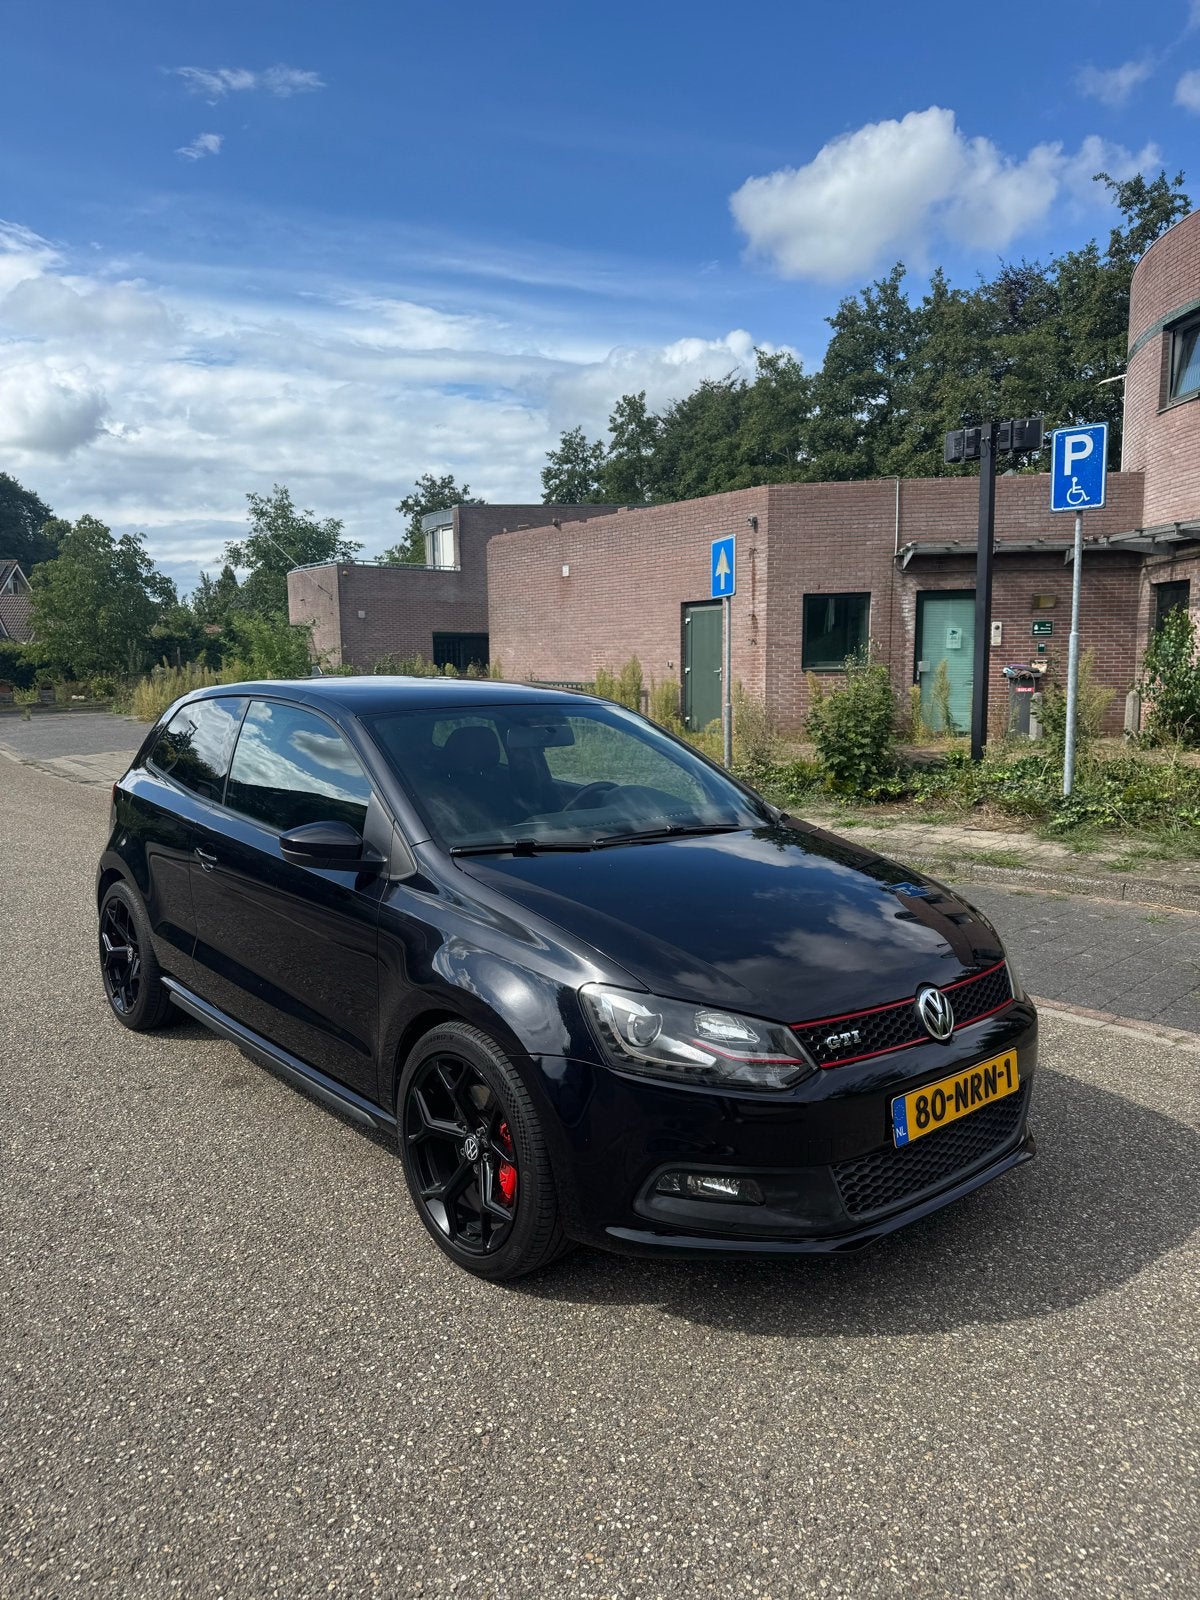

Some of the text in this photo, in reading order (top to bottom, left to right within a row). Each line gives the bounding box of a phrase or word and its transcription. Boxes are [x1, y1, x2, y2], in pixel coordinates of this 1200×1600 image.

[1064, 434, 1094, 476] P
[826, 1030, 861, 1049] GTI
[915, 1058, 1013, 1129] 80-NRN-1
[896, 1126, 907, 1138] NL
